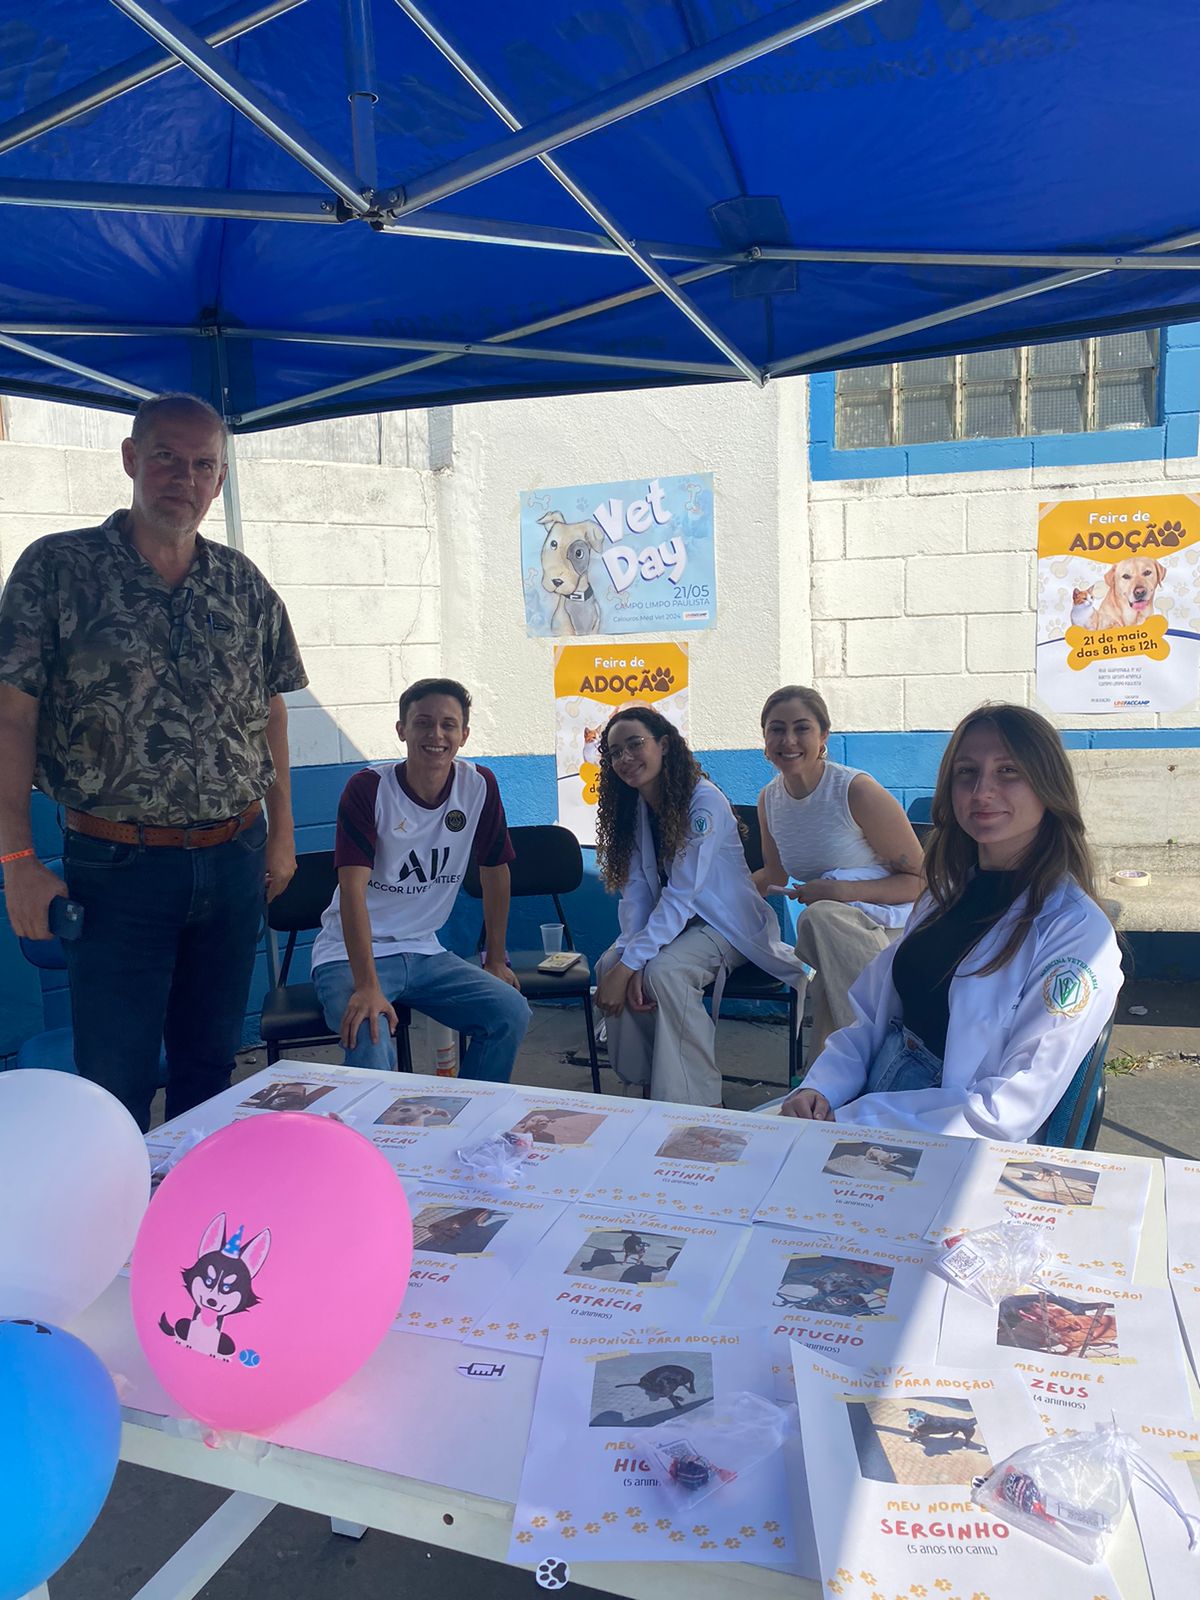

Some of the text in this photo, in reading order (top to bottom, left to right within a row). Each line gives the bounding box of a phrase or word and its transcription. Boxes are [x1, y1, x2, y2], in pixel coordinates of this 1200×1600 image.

[593, 479, 672, 544] Vet
[1089, 510, 1150, 524] Feira de
[601, 536, 686, 593] Day
[674, 584, 710, 599] 21/05
[614, 598, 710, 610] CAMPO LIMPO PAULISTA
[1083, 630, 1148, 646] 21 de maio
[1076, 639, 1158, 659] das 8h às 12h
[594, 656, 645, 668] Feira de
[368, 880, 404, 894] ACCOR
[372, 1136, 418, 1145] CACAU
[1050, 1154, 1078, 1165] PARA
[1080, 1160, 1126, 1172] ADOÇÃO!
[654, 1168, 716, 1182] RITINHA
[833, 1188, 885, 1202] VILMA
[500, 1200, 544, 1210] ADOÇÃO!
[1031, 1206, 1064, 1214] NOME
[578, 1212, 717, 1236] DISPONÍVEL PARA ADOÇÃO!
[772, 1238, 924, 1264] DISPONÍVEL PARA ADOÇÃO!
[410, 1270, 450, 1283] RICA
[570, 1282, 597, 1290] MEU
[600, 1286, 633, 1296] NOME
[1050, 1278, 1143, 1301] PARA ADOÇÃO!
[783, 1314, 811, 1324] MEU
[815, 1319, 850, 1329] NOME
[570, 1335, 740, 1346] DISPONÍVEL PARA ADOÇÃO!
[773, 1325, 864, 1347] PITUCHO
[812, 1363, 994, 1392] DISPONÍVEL PARA ADOÇÃO!
[1014, 1362, 1105, 1384] MEU NOME É
[1030, 1378, 1089, 1398] ZEUS
[1032, 1394, 1042, 1402] (4
[604, 1442, 636, 1450] MEU
[623, 1478, 632, 1488] (5
[887, 1500, 920, 1512] MEU
[928, 1501, 972, 1514] NOME
[880, 1518, 1010, 1540] SERGINHO
[907, 1544, 918, 1556] (5
[920, 1545, 946, 1556] anos
[948, 1546, 963, 1556] no
